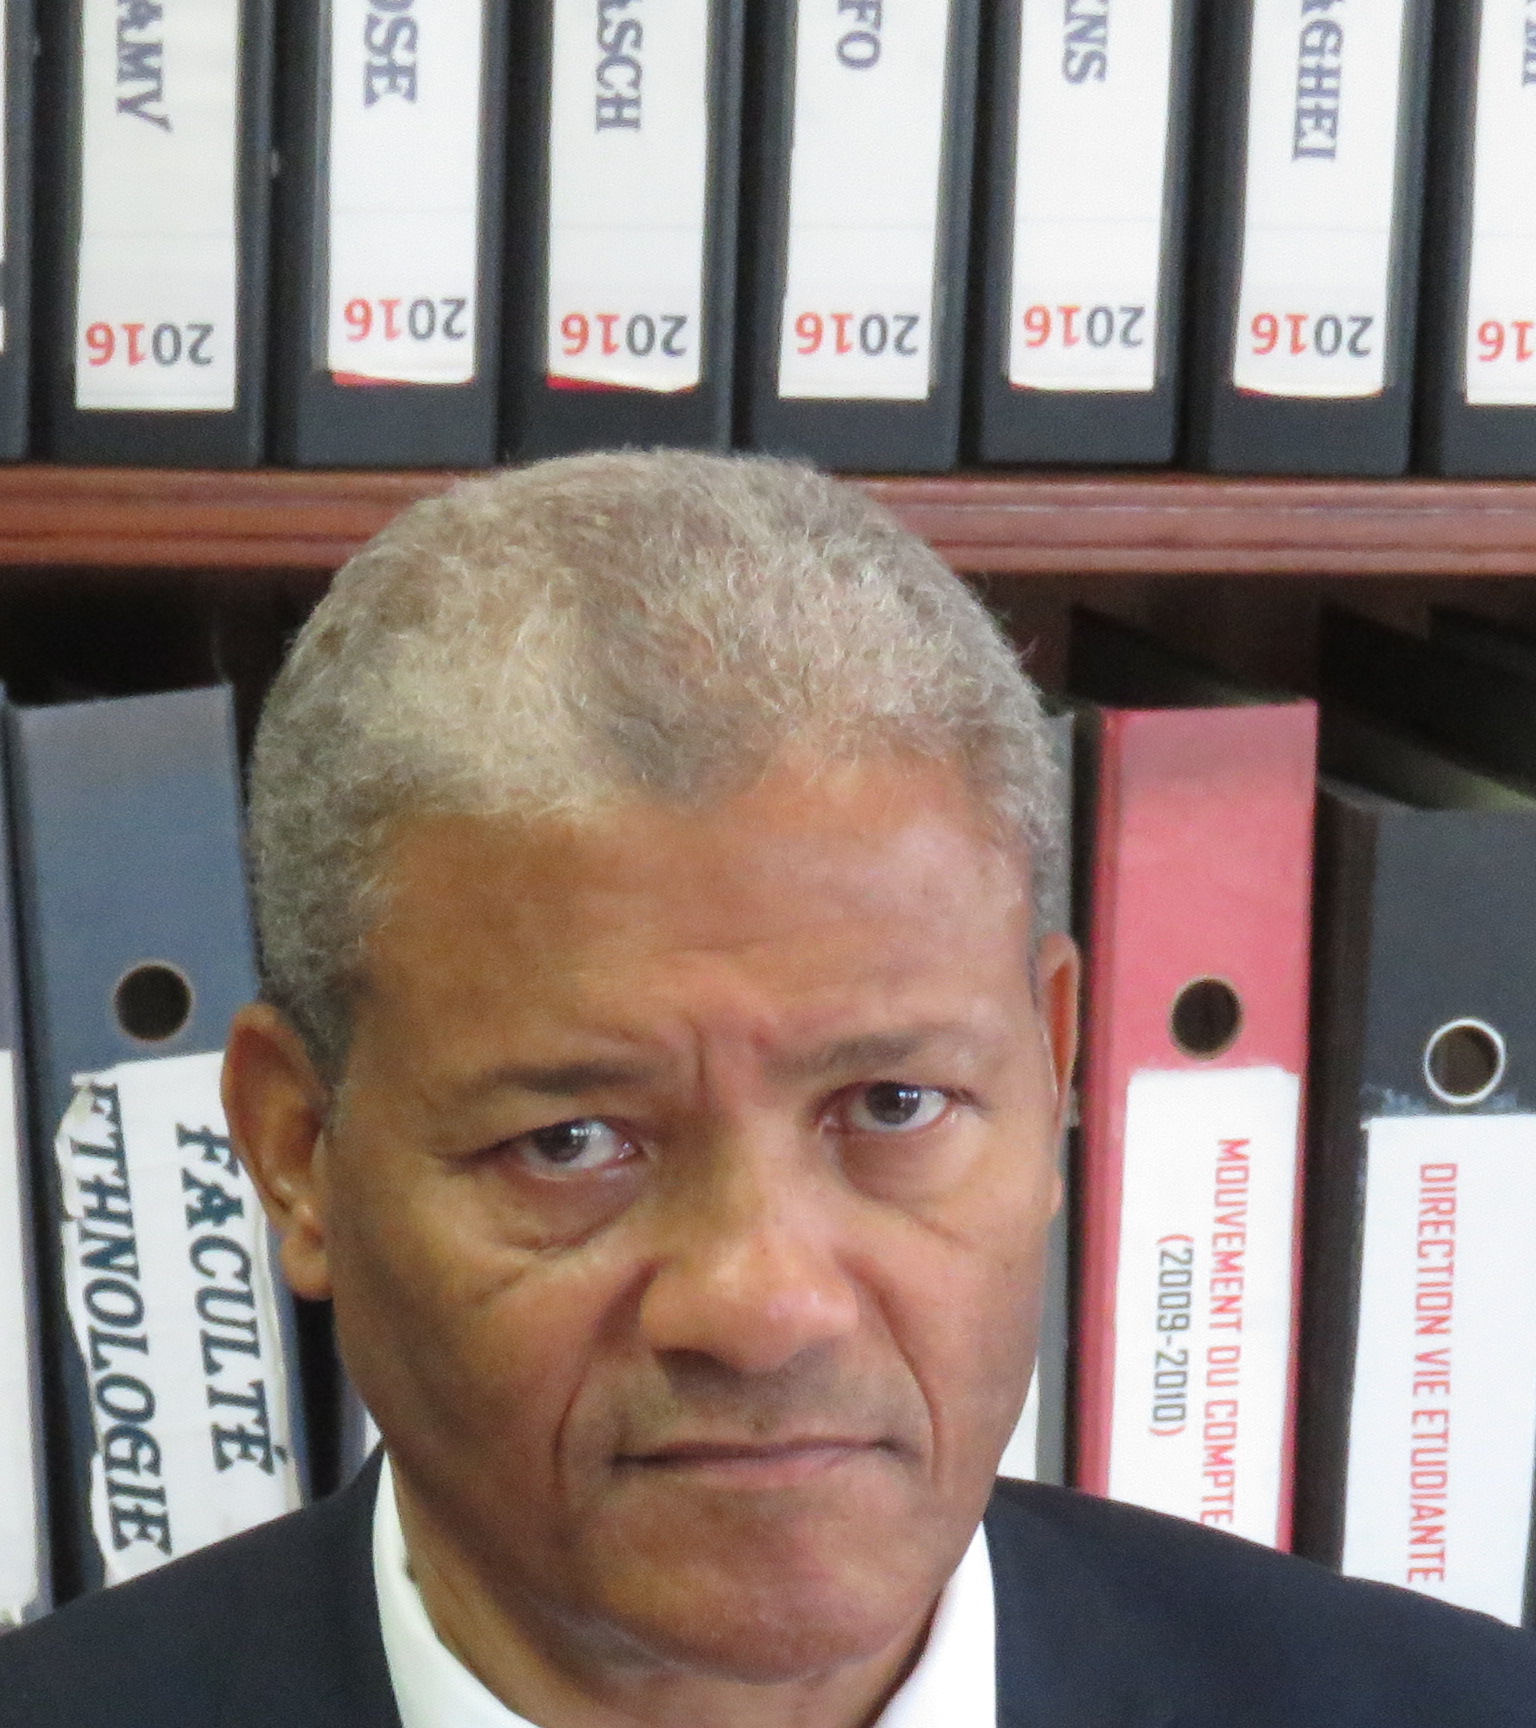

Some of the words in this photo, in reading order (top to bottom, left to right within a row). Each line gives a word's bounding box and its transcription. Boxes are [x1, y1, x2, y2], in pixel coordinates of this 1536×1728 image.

[86, 322, 216, 367] 2016
[343, 298, 467, 342] 2016
[561, 312, 689, 358] 2016
[794, 311, 921, 356] 2016
[1022, 304, 1146, 349] 2016
[1250, 312, 1374, 358] 2016
[1208, 1137, 1251, 1335] MOUVEMENT
[1414, 1162, 1459, 1337] DIRECTION
[176, 1122, 289, 1478] FACULTÉ
[1149, 1233, 1195, 1440] (2009-2010)
[1206, 1344, 1242, 1391] DU
[1412, 1346, 1453, 1398] VIE
[1200, 1398, 1240, 1526] COMPTE
[1407, 1407, 1451, 1583] ETUDIANTE
